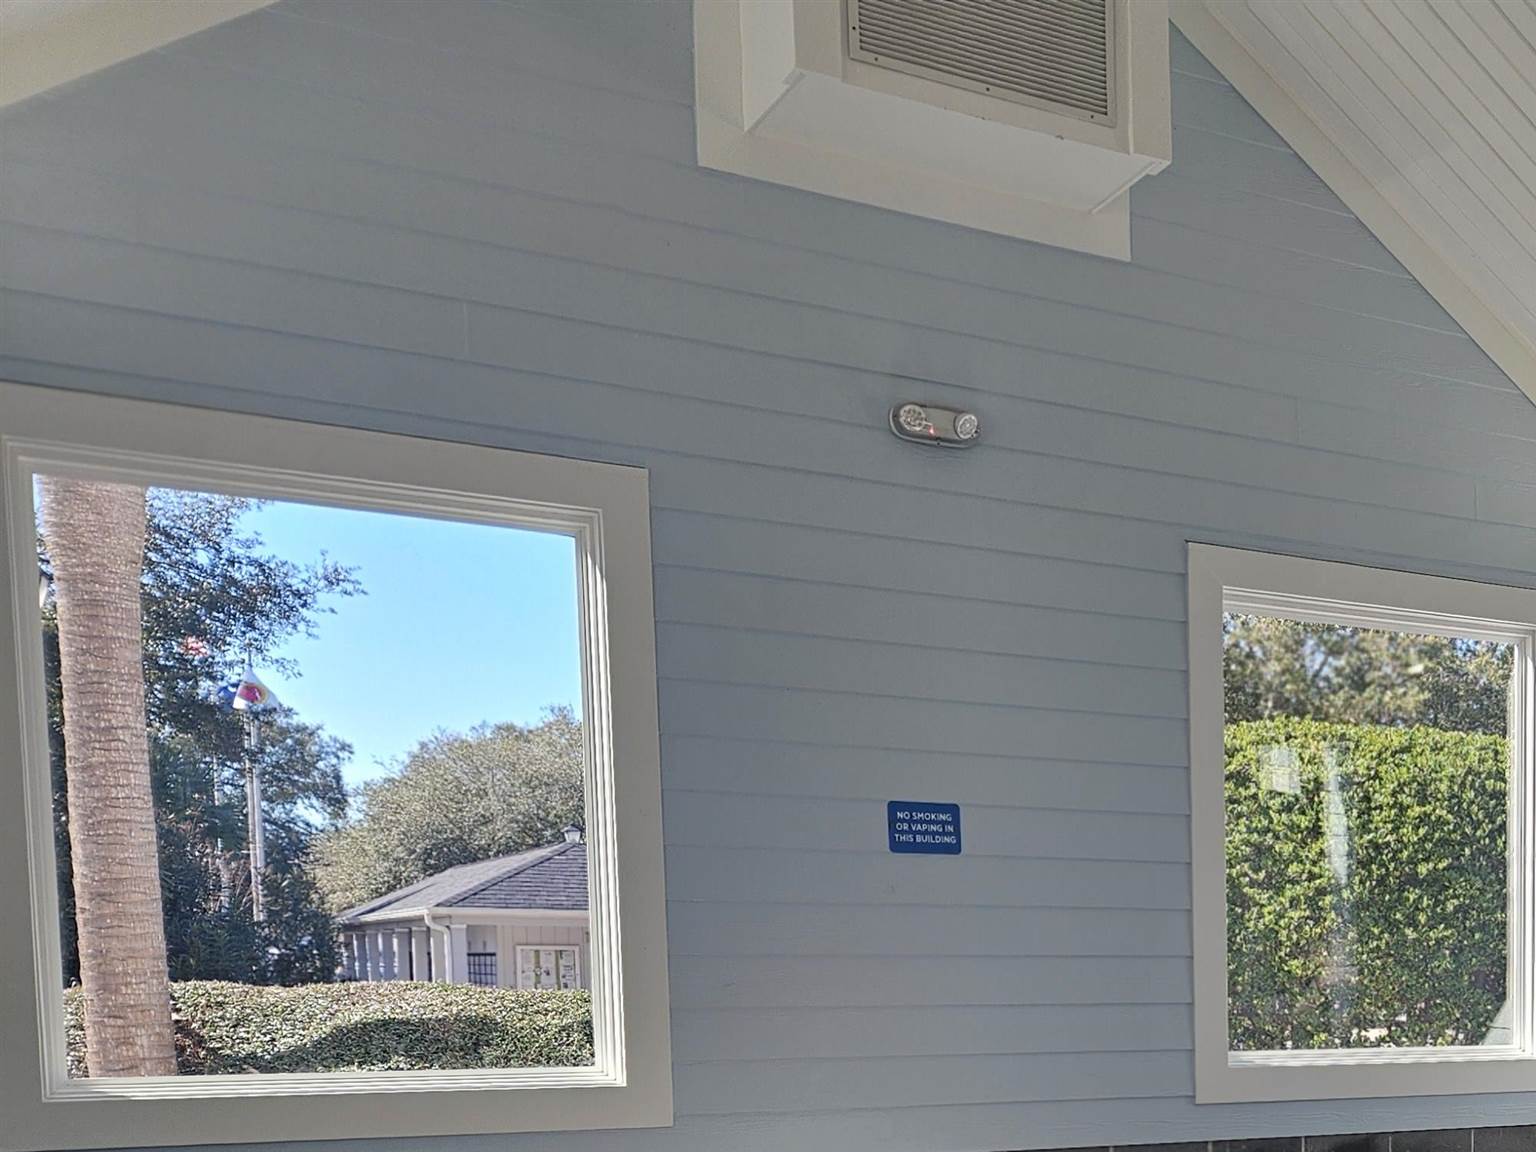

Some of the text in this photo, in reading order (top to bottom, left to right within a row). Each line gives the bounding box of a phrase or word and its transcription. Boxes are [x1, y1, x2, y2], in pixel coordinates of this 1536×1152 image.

[896, 811, 952, 821] NO SMOKING
[896, 823, 954, 832] OR VAPING IN
[894, 834, 957, 844] THIS BUILDING
